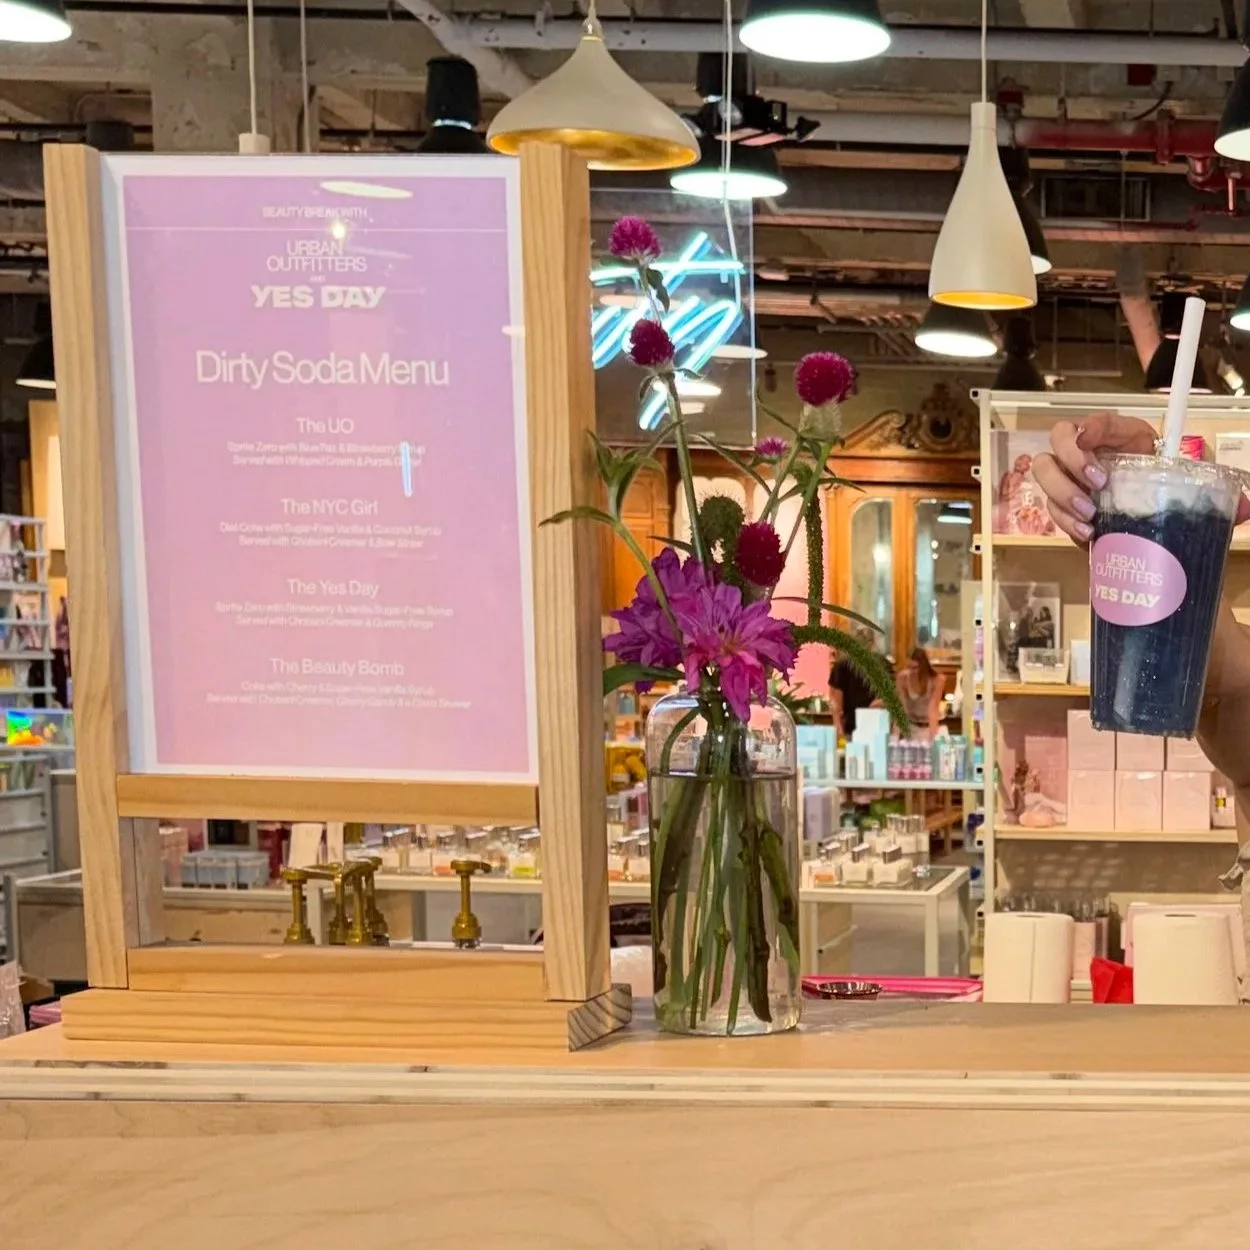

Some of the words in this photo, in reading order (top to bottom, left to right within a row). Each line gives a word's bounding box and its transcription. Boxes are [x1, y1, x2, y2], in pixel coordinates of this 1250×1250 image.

[262, 206, 304, 219] BEAUTY
[304, 206, 340, 219] BREAK
[341, 206, 368, 219] WITH
[286, 240, 344, 257] URBAN
[266, 255, 368, 272] OUTFITTERS
[250, 285, 315, 308] YES
[320, 285, 387, 308] DAY
[195, 350, 269, 390] Dirty
[272, 350, 355, 386] Soda
[359, 351, 450, 387] Menu
[296, 416, 326, 434] The
[328, 416, 355, 435] UO
[280, 498, 311, 516] The
[312, 498, 348, 516] NYC
[351, 499, 379, 517] Girl
[1105, 552, 1147, 571] URBAN
[1095, 562, 1164, 587] OUTFITTERS
[286, 577, 317, 595] The
[318, 579, 347, 597] Yes
[349, 579, 380, 599] Day
[1094, 583, 1119, 602] YES
[1121, 589, 1161, 608] DAY
[270, 657, 300, 674] The
[302, 658, 356, 677] Beauty
[358, 660, 405, 676] Bomb
